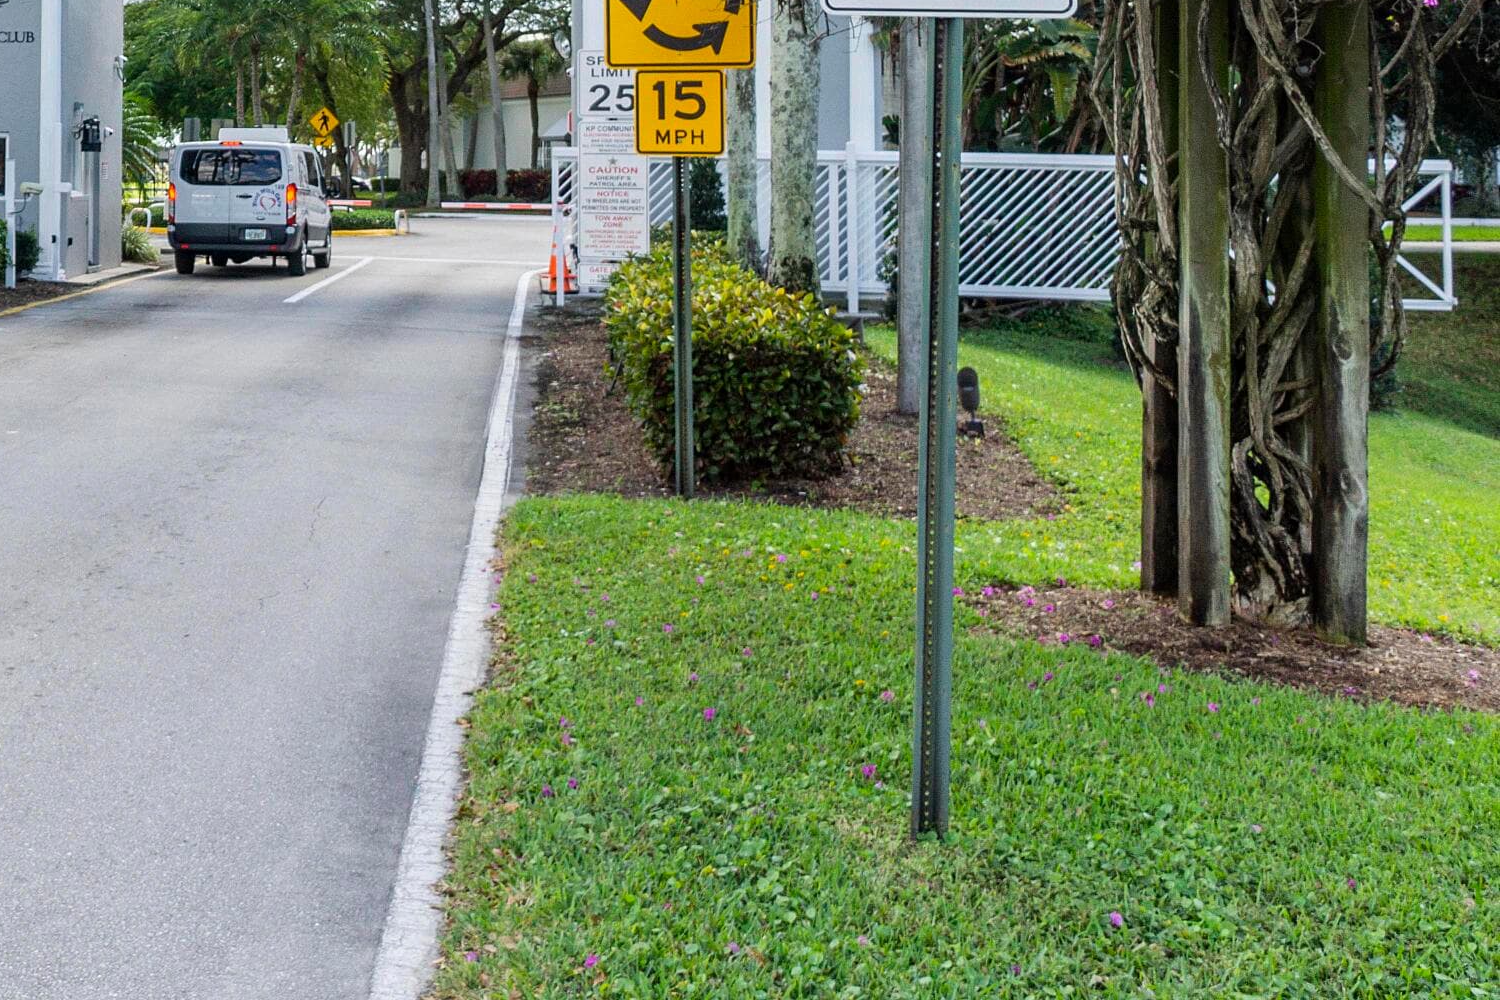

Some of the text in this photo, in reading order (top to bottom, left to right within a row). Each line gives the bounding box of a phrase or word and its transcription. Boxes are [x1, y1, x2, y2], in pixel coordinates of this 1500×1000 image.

[588, 83, 635, 112] 25
[652, 80, 706, 120] 15
[656, 129, 704, 145] MPH
[588, 166, 638, 174] CAUTION
